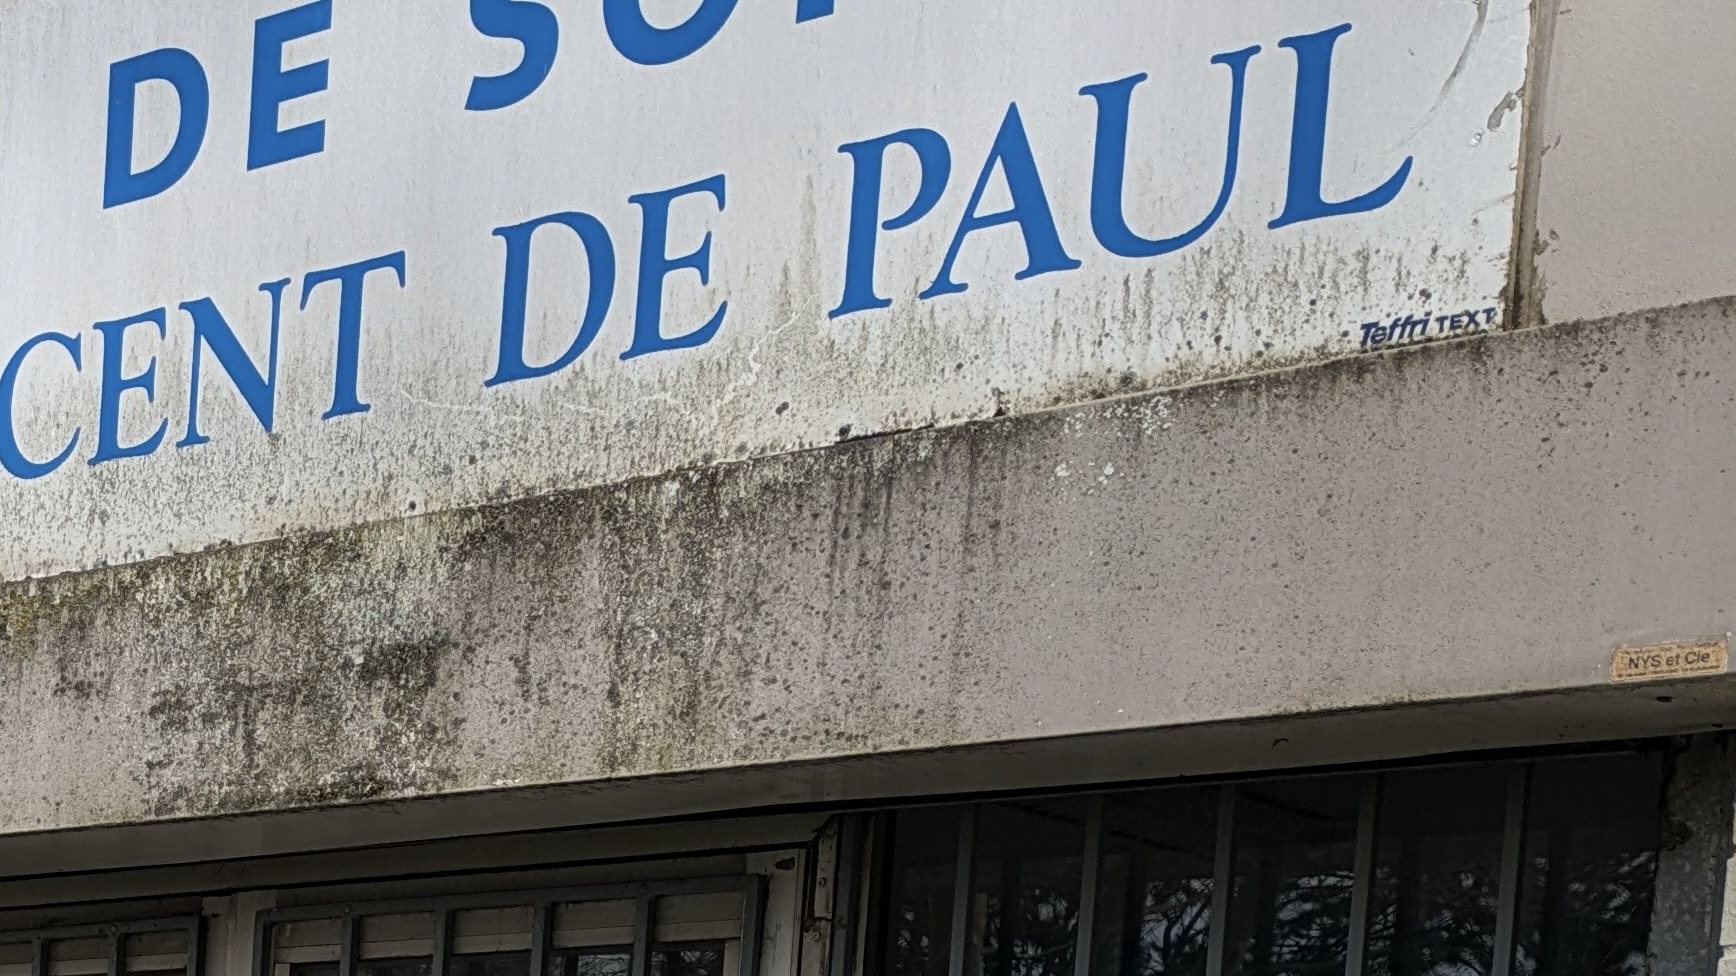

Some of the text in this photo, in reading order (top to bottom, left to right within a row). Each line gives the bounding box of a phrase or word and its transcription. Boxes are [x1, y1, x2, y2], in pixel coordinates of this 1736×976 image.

[103, 0, 332, 209] DE
[485, 174, 727, 388] DE
[828, 23, 1413, 319] PAUL
[1666, 654, 1680, 667] et
